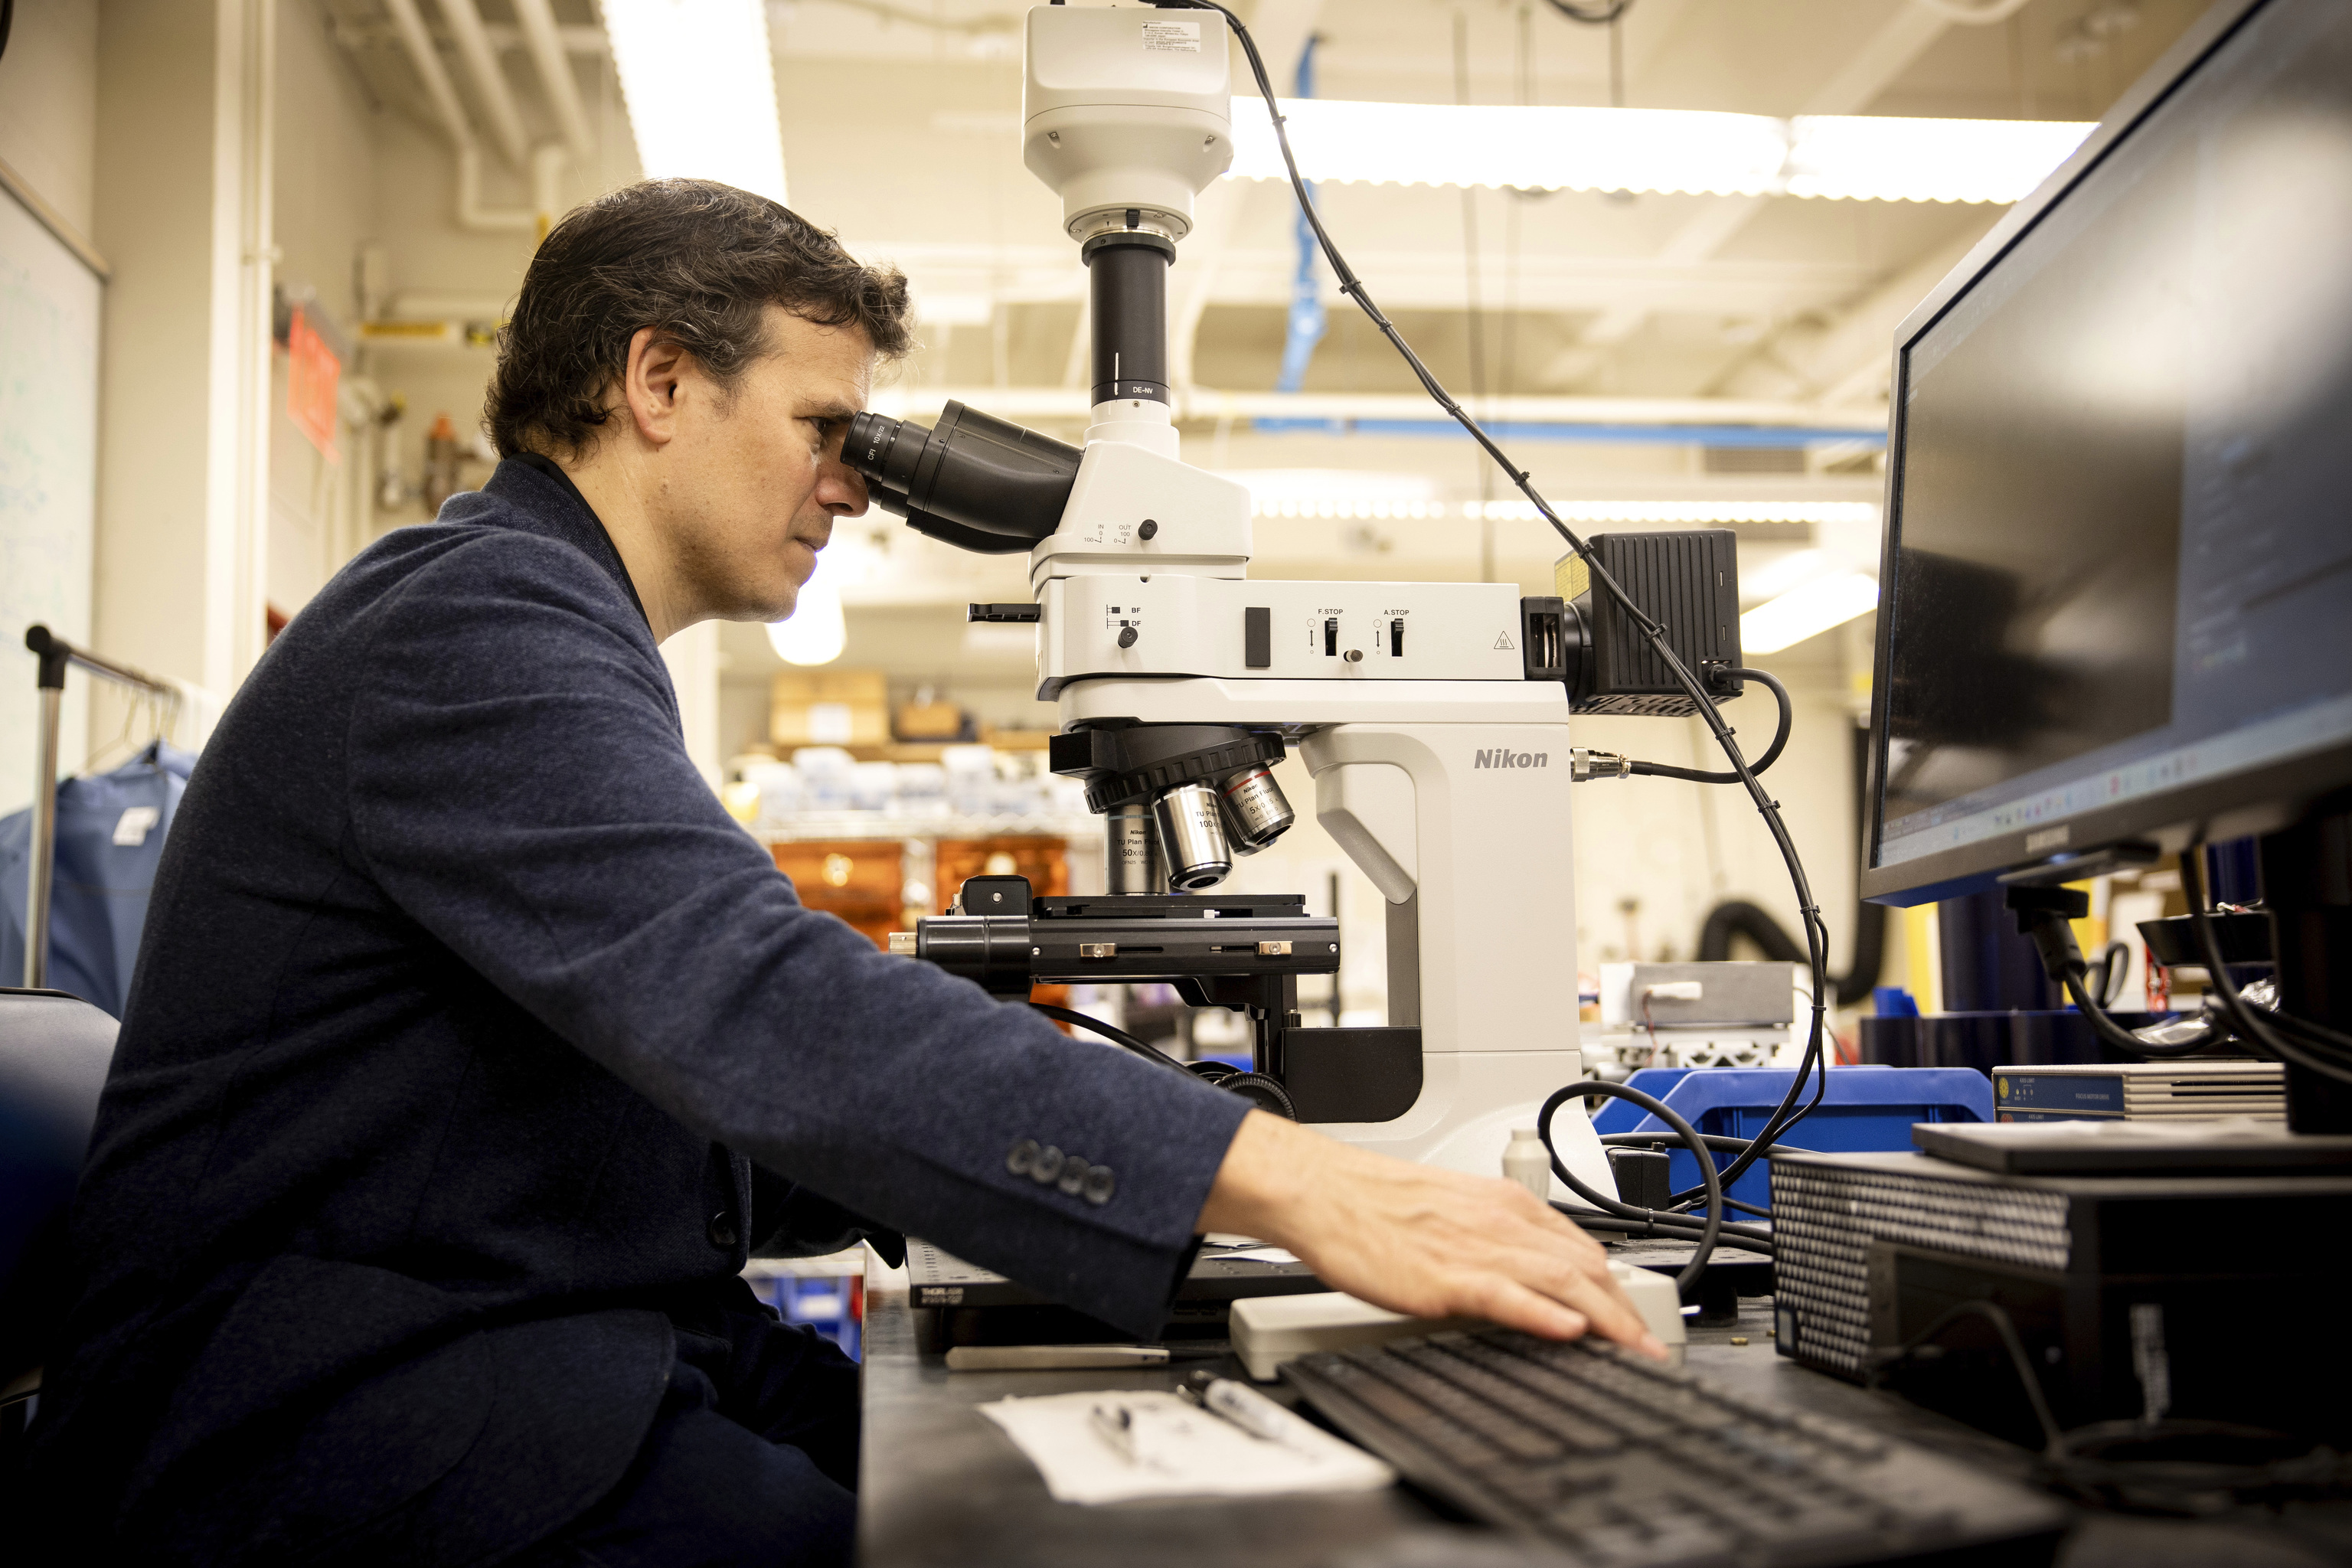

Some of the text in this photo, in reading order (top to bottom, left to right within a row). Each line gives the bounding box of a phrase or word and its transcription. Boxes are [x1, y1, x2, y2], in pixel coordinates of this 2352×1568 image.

[1132, 386, 1153, 394] DE-NV
[867, 425, 885, 460] CFI 10X/22
[1474, 748, 1548, 769] Nikon
[1236, 787, 1274, 810] TU Plan Fluor
[1243, 783, 1258, 794] Nikon
